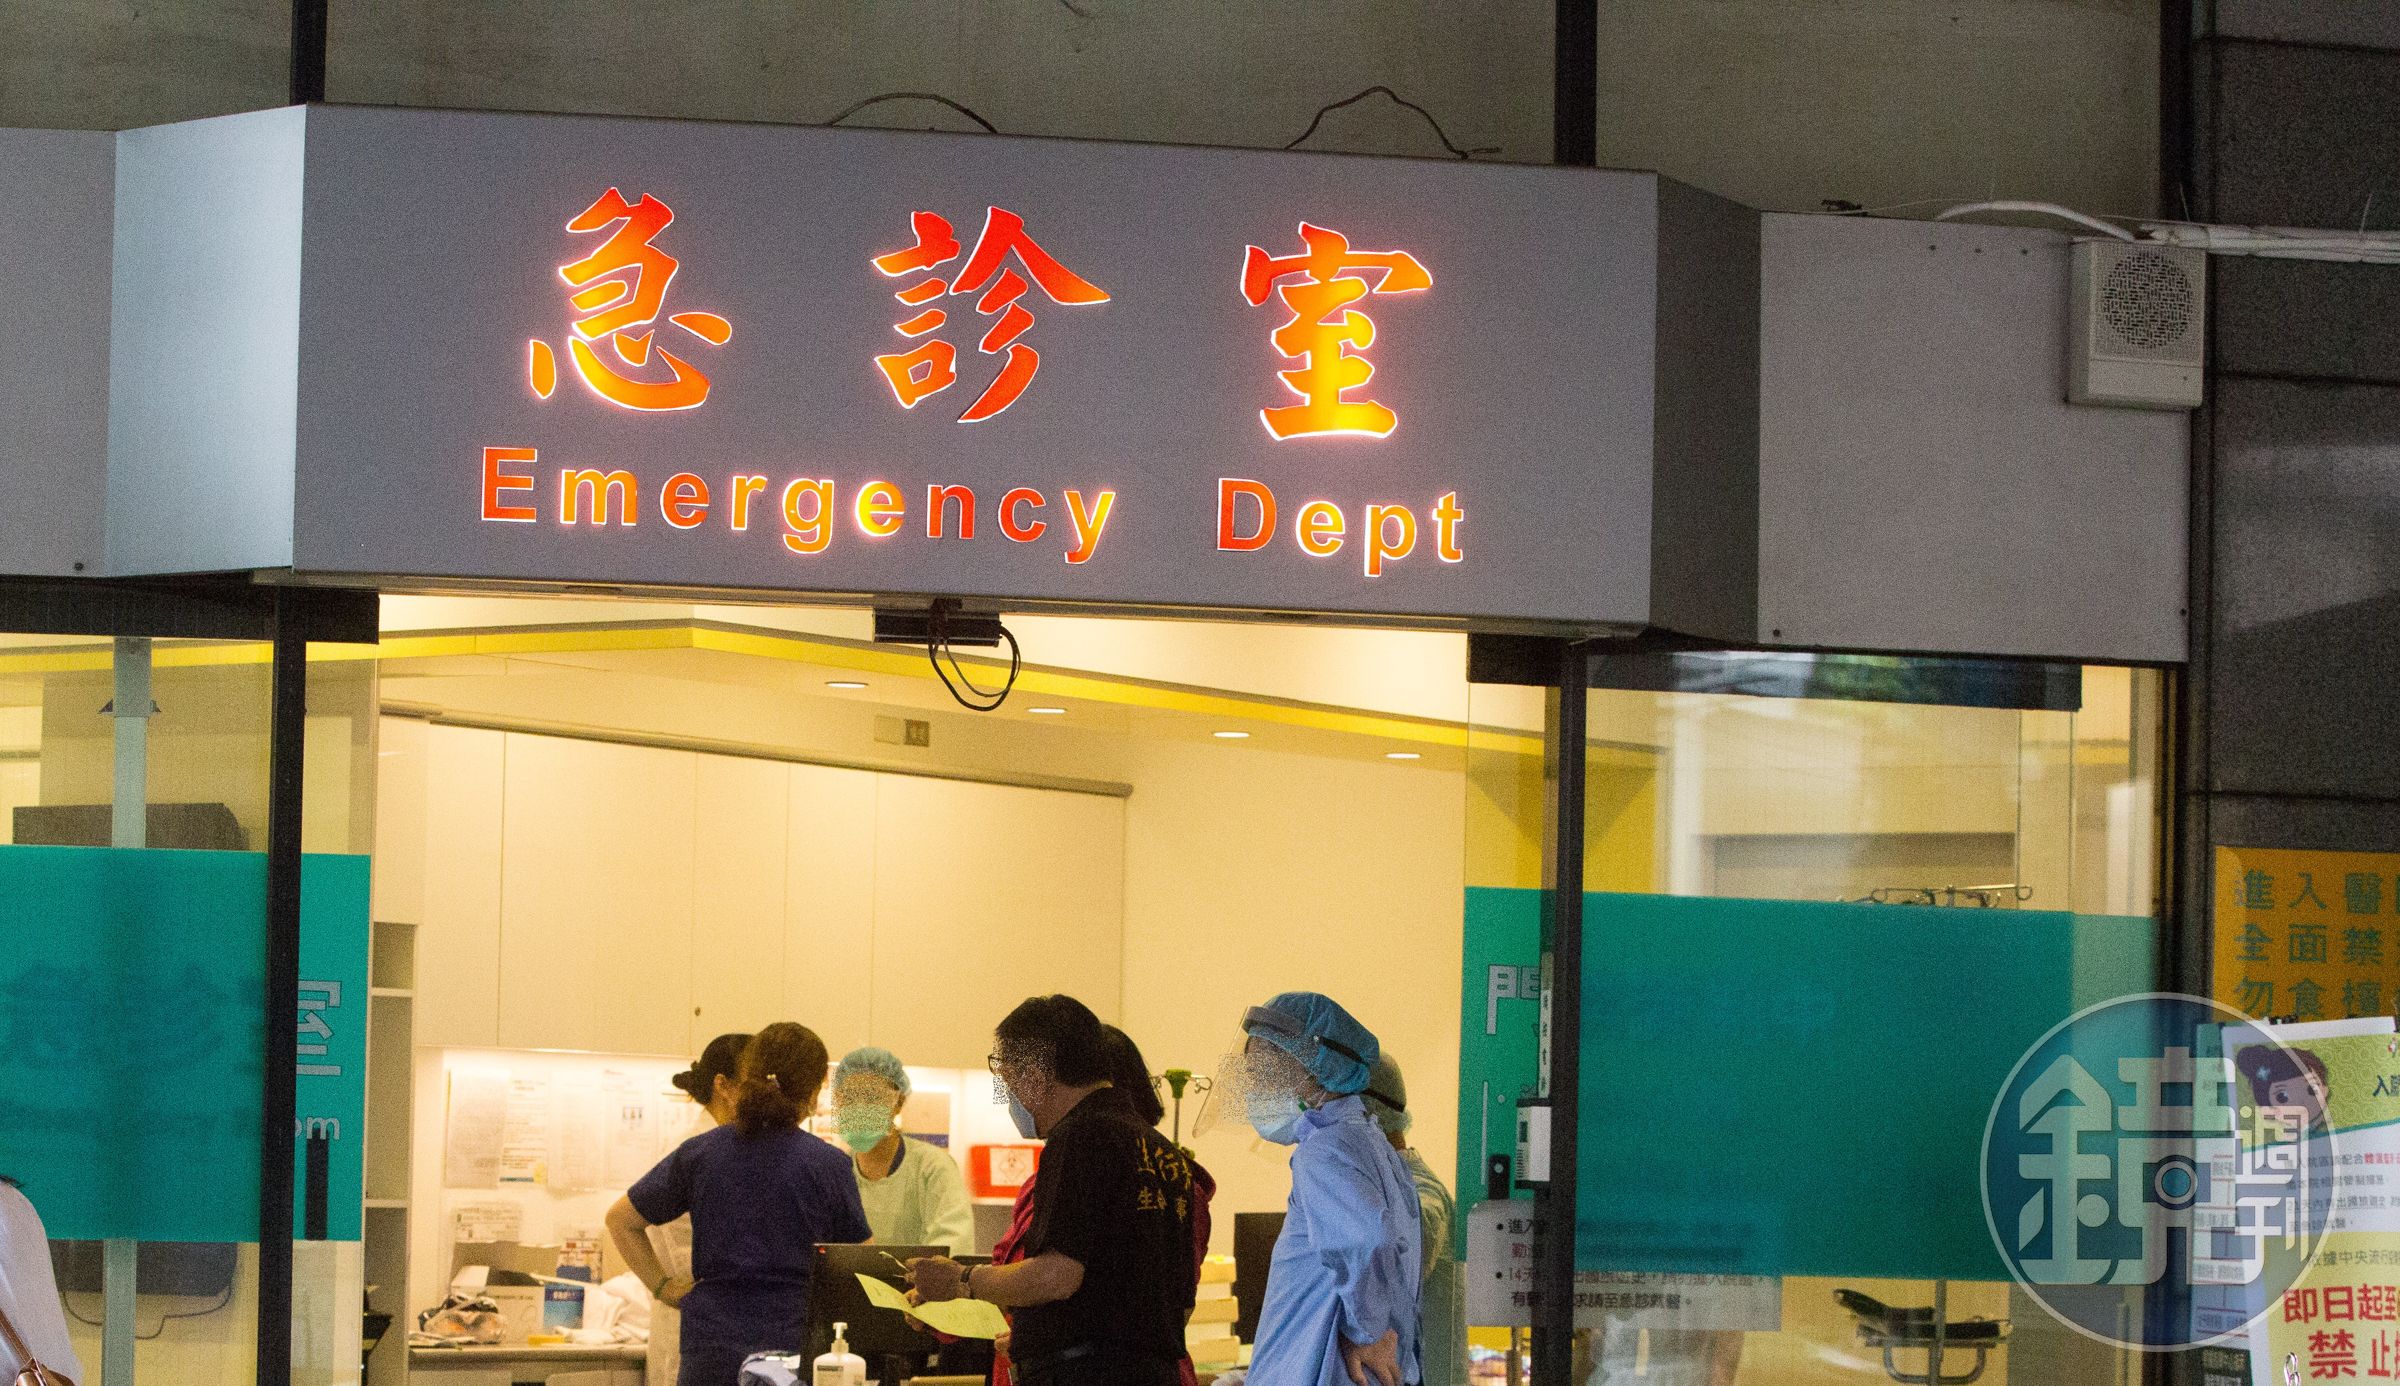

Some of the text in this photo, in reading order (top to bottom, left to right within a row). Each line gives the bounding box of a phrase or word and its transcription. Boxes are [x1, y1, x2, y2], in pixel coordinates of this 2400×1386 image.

[529, 186, 1434, 442] 急診室
[479, 446, 1466, 578] Emergency Dept
[2234, 868, 2400, 915] 進入醫
[2233, 923, 2400, 967] 全面禁
[2233, 975, 2400, 1020] 勿食檳
[2307, 1328, 2400, 1381] 禁止
